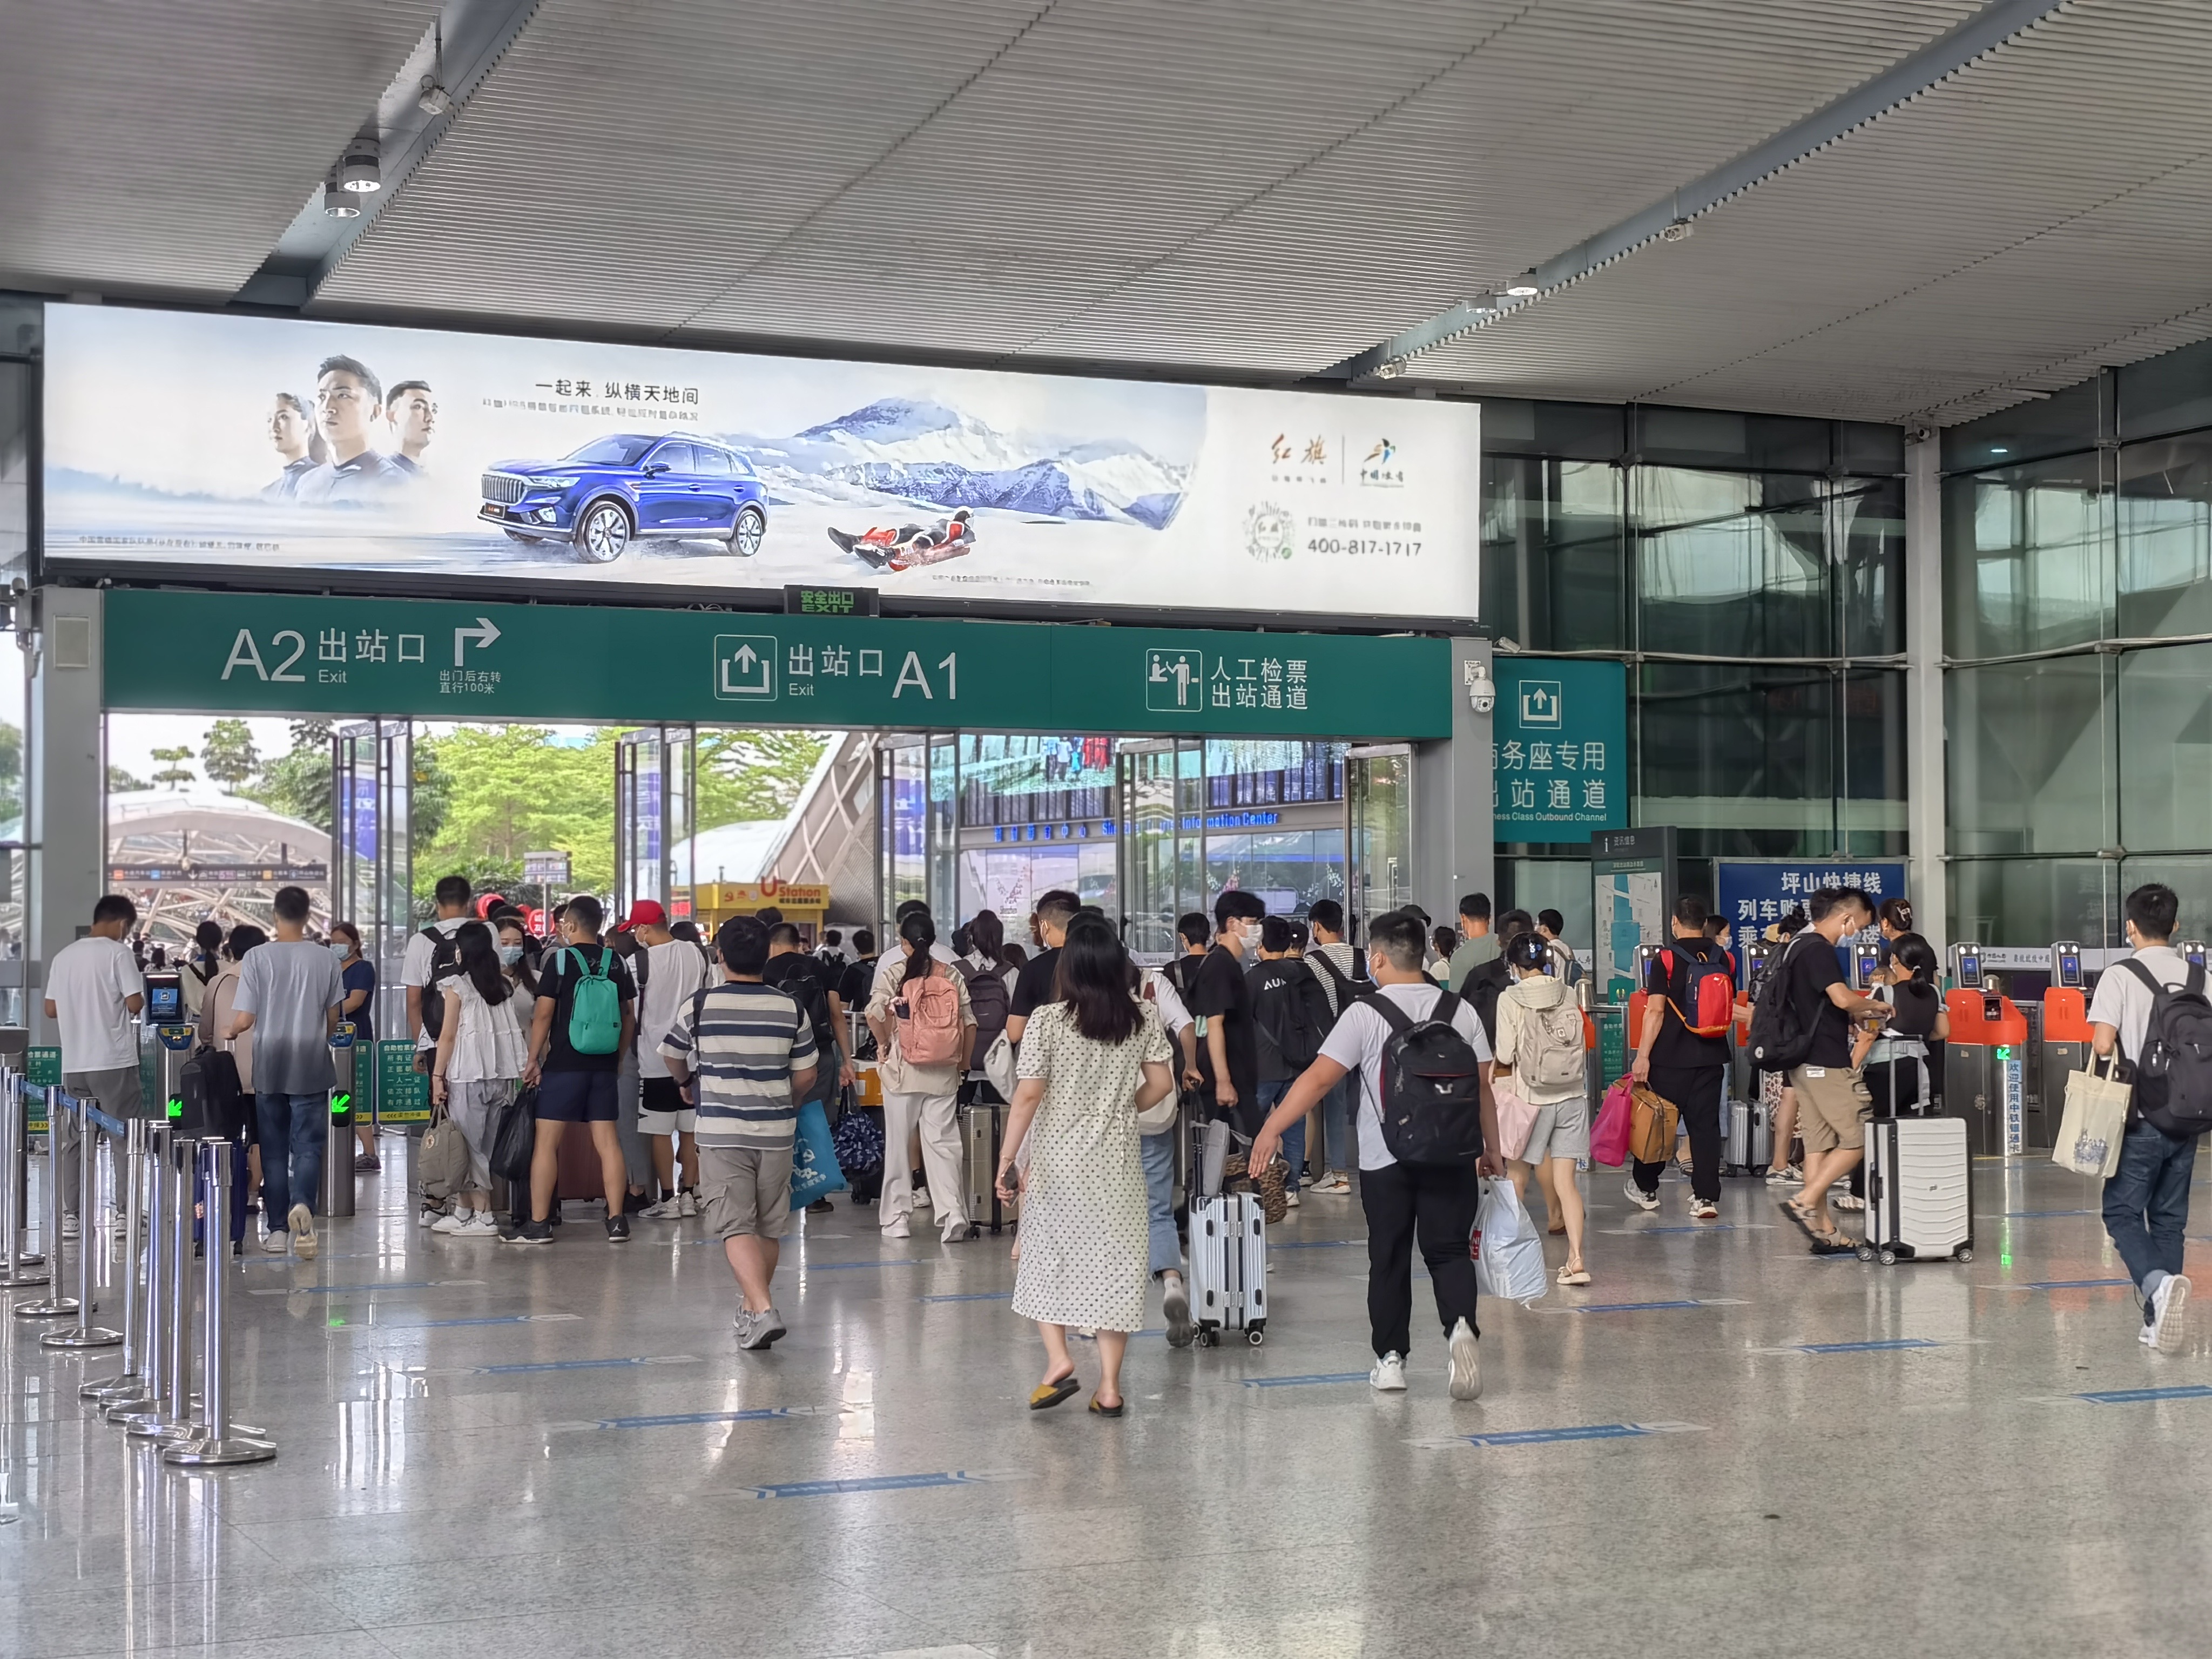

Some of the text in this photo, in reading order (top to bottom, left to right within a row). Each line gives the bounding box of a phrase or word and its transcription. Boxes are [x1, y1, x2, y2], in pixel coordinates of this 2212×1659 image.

[605, 382, 698, 405] 纵横天地间
[1308, 538, 1421, 557] 400-817-1717
[801, 590, 854, 605] 安全出口
[802, 604, 853, 613] EXIT
[221, 628, 424, 682] A2 出站口
[319, 670, 347, 683] Exit
[440, 670, 501, 682] 出门后右转
[789, 644, 956, 699] 出站口 A1
[1210, 657, 1307, 684] 人工检票
[440, 682, 495, 694] 直行100米
[790, 683, 814, 696] Exit
[1212, 684, 1308, 710] 出站通道
[1182, 815, 1240, 830] Infomation
[1243, 811, 1278, 826] Center
[1512, 812, 1534, 820] Class
[1535, 812, 1573, 821] Outbound
[1575, 813, 1607, 821] Channel
[1781, 872, 1882, 894] 坪山快捷线
[779, 887, 821, 897] Station
